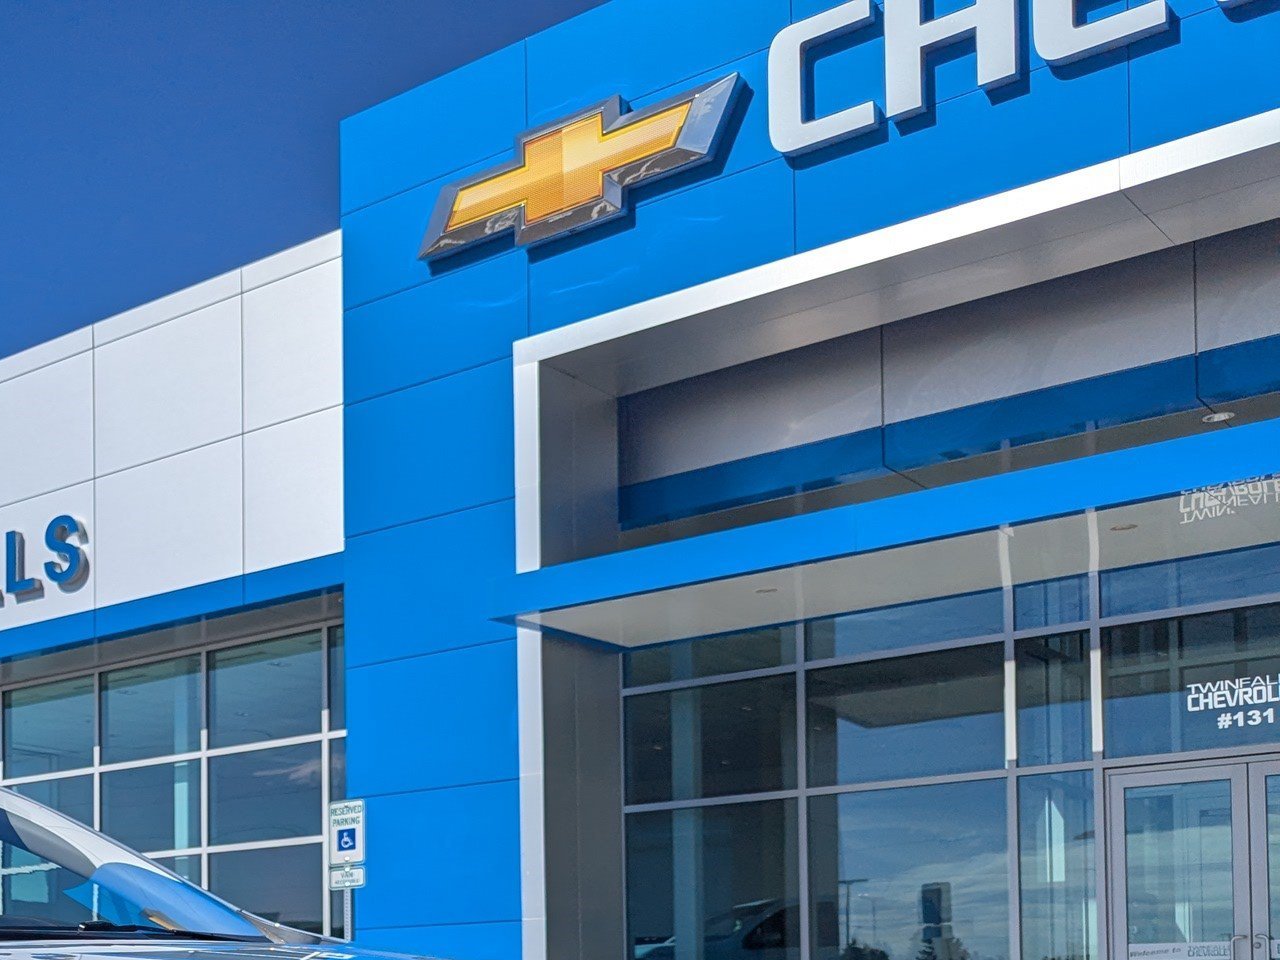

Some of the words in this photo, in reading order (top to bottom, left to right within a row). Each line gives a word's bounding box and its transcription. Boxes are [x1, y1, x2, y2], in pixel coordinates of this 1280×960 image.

[1187, 673, 1280, 695] TWINFAL
[1187, 685, 1280, 712] CHEVROL
[1217, 708, 1274, 730] #131
[330, 805, 363, 817] RESERVED
[332, 816, 360, 827] PARKING
